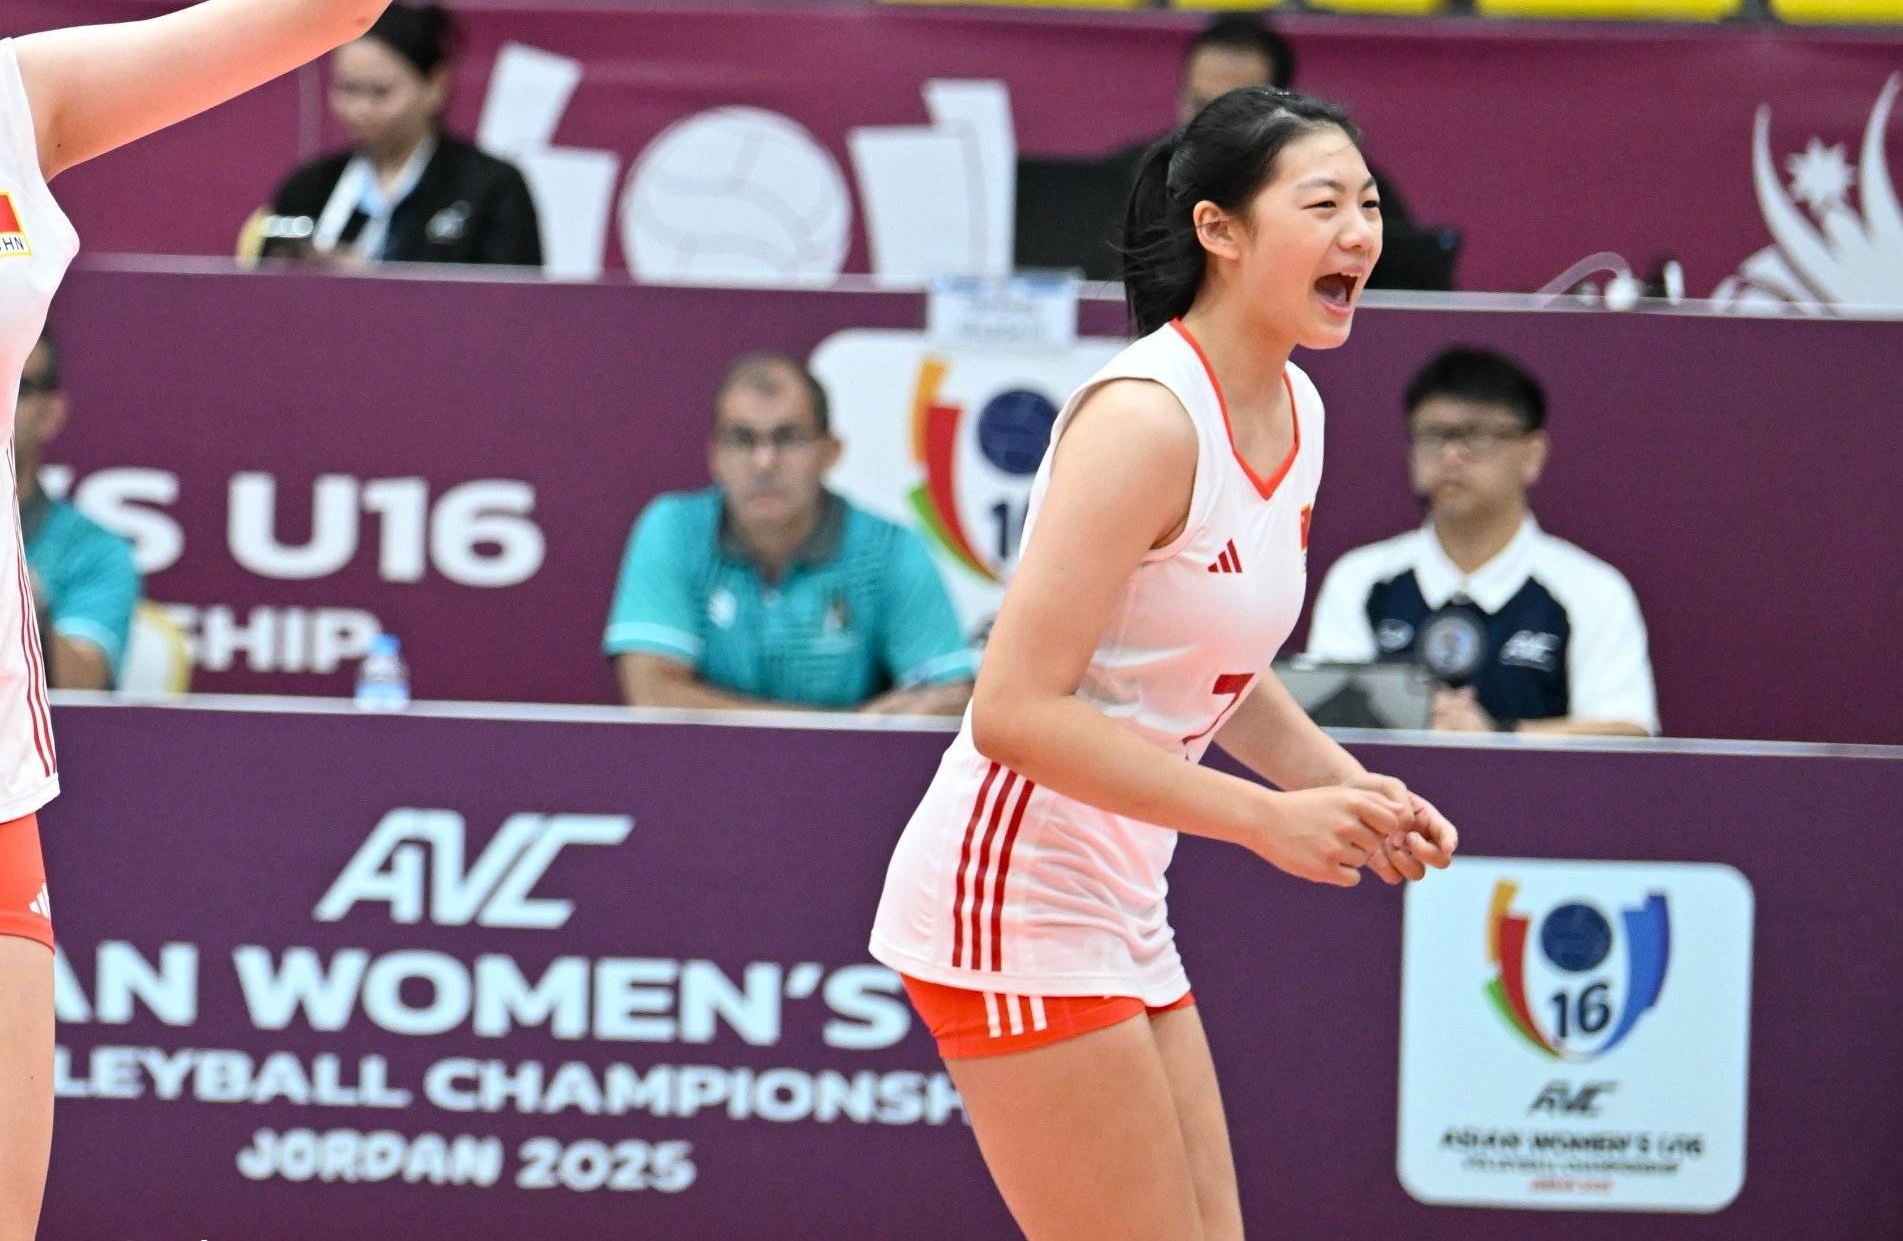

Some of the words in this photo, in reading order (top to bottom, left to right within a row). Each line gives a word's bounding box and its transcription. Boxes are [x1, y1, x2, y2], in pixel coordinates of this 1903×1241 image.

[227, 473, 545, 587] U16
[312, 807, 637, 930] AVC
[232, 944, 912, 1050] WOMEN'S
[1550, 981, 1613, 1040] 16
[236, 1126, 505, 1189] JORDAN
[513, 1134, 697, 1194] 2025
